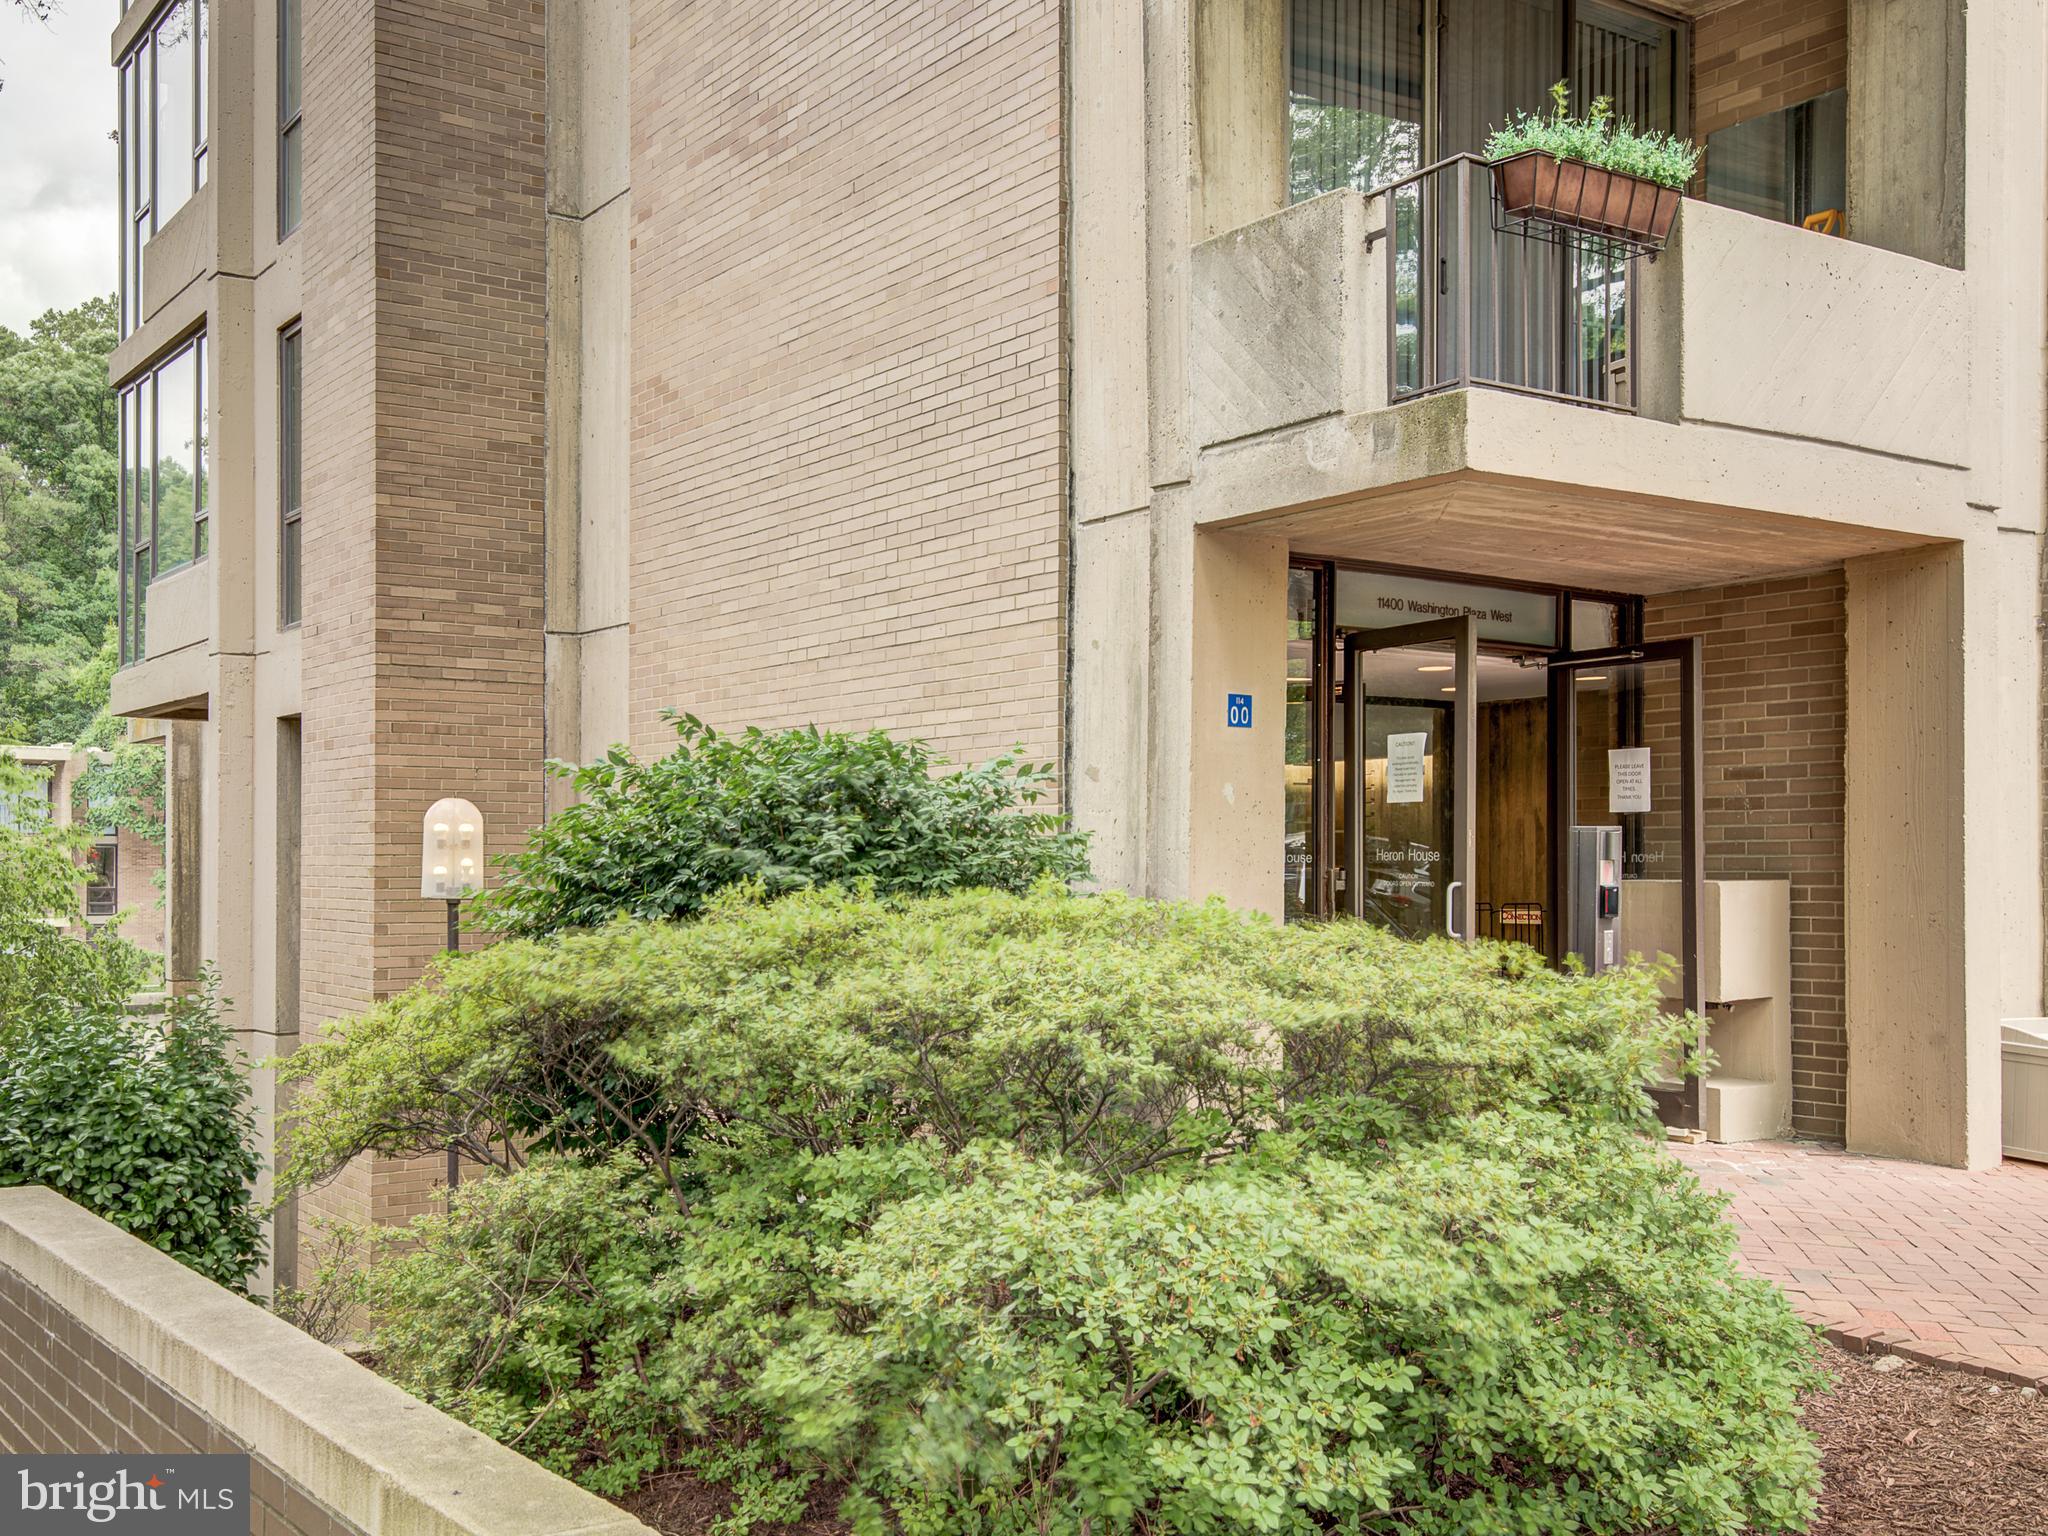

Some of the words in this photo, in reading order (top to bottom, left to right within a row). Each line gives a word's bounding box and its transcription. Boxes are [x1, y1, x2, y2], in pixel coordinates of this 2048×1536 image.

[1377, 597, 1404, 611] 11400
[1407, 600, 1460, 618] Washington
[1462, 606, 1487, 620] Plaza
[1490, 609, 1513, 623] West
[1230, 705, 1249, 724] 00
[1286, 854, 1313, 864] ouse
[1376, 848, 1404, 861] Heron
[1408, 849, 1440, 862] House
